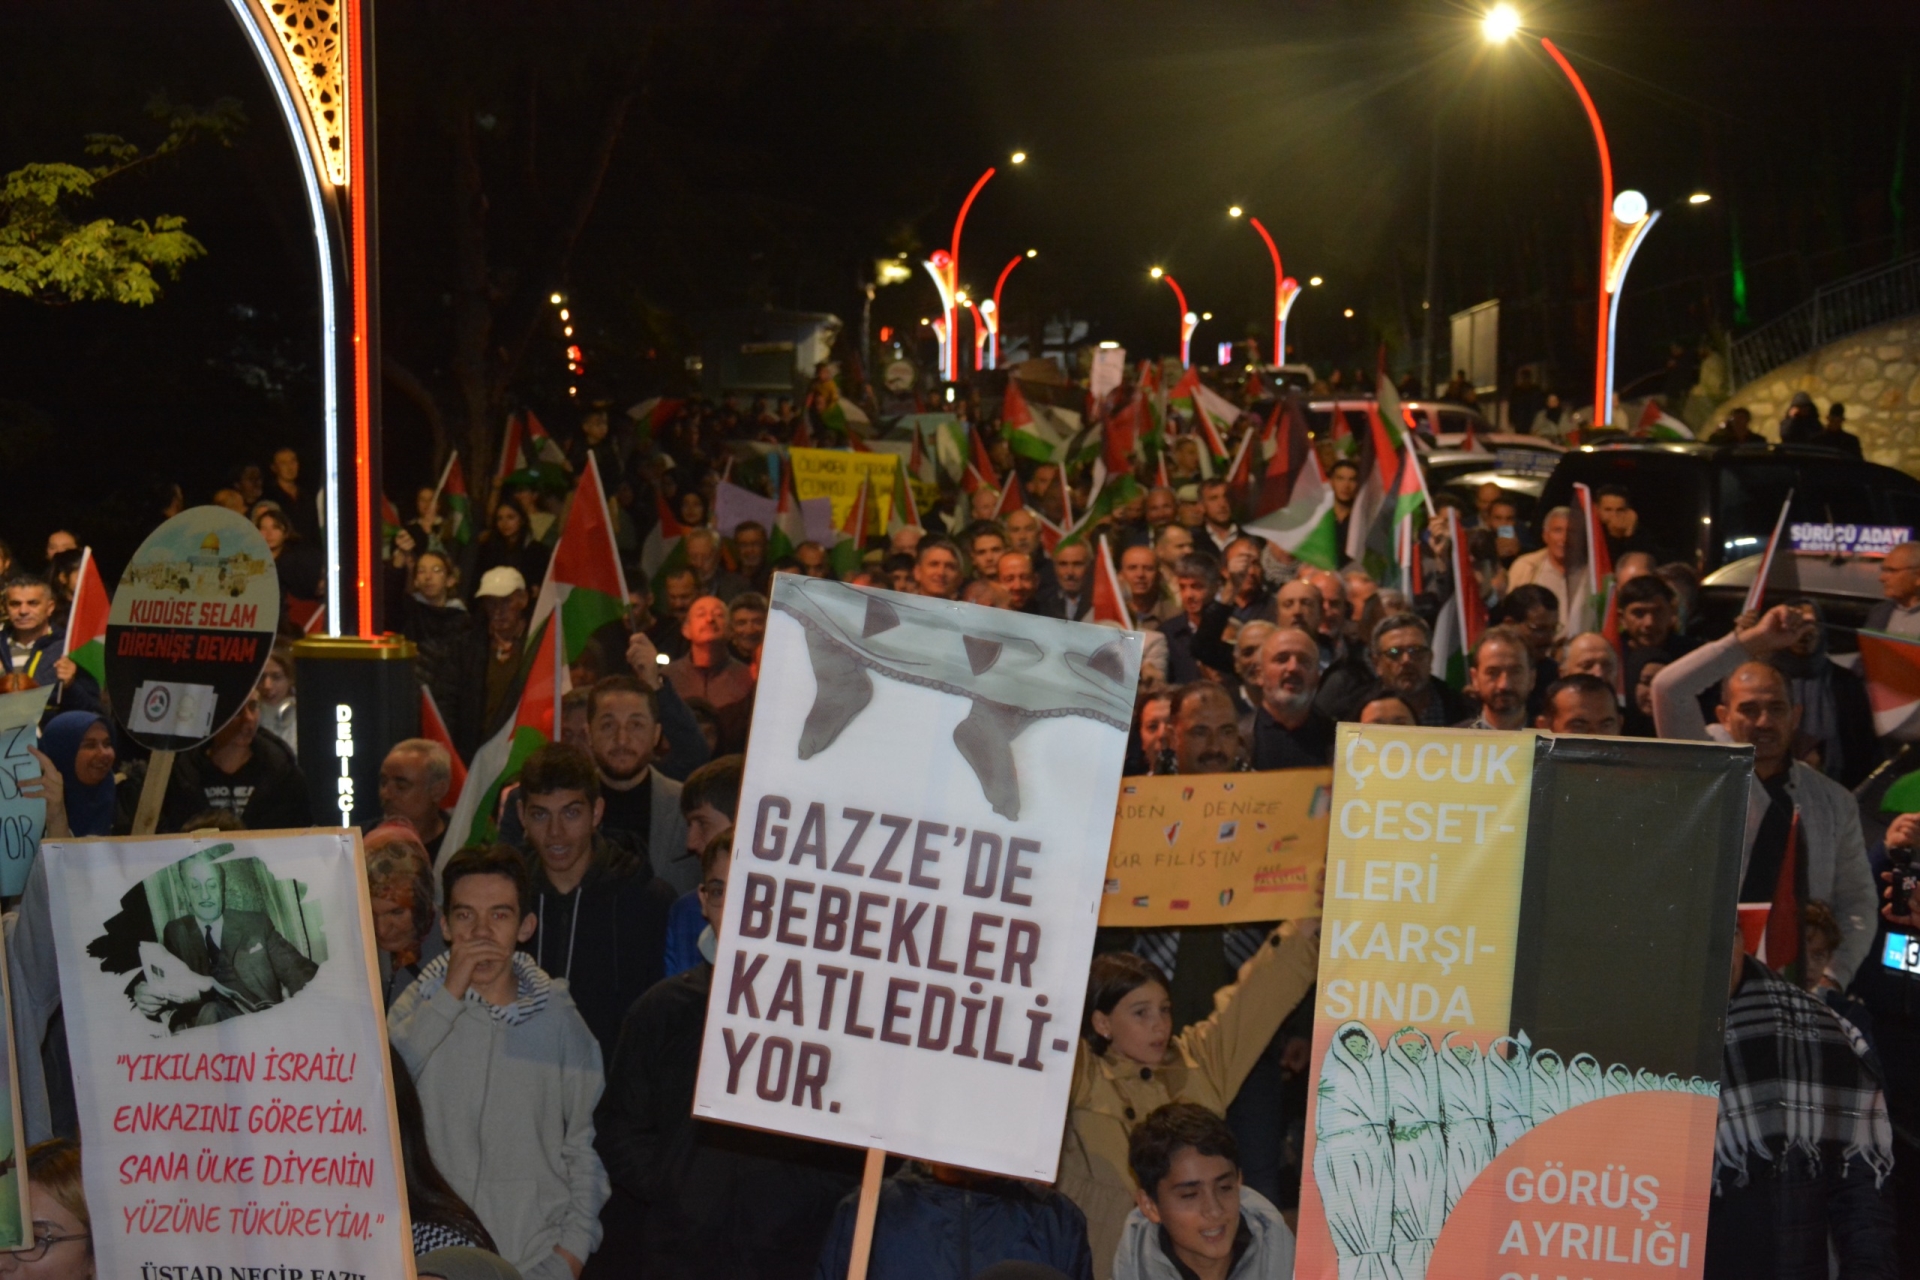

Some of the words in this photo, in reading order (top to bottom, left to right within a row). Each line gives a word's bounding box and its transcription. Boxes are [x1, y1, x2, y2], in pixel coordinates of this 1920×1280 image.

[1790, 522, 1857, 543] SÜRÜCÜ
[1858, 527, 1909, 544] ADAYI
[129, 596, 197, 626] KUDÜSE
[198, 602, 258, 629] SELAM
[117, 627, 195, 663] DİRENİŞE
[195, 635, 258, 663] DEVAM
[1345, 739, 1519, 791] ÇOCUK
[0, 814, 34, 860] OR
[1339, 799, 1515, 845] CESET-
[752, 795, 1041, 906] GAZZE'DE
[1334, 853, 1439, 904] LERİ
[739, 872, 1042, 988] BEBEKLER
[1329, 919, 1496, 976] KARŞI-
[727, 950, 1069, 1072] KATLEDİLİ-
[1324, 978, 1475, 1026] SINDA
[263, 1046, 357, 1084] İSRAİL!
[722, 1028, 841, 1114] YOR.
[113, 1102, 242, 1135] ENKAZINI
[248, 1098, 367, 1136] GÖREYİM.
[119, 1152, 189, 1185] SANA
[197, 1148, 255, 1184] ÜLKE
[262, 1150, 375, 1188] DİYENİN
[1505, 1160, 1660, 1221] GÖRÜŞ
[123, 1198, 221, 1234] YÜZÜNE
[1498, 1220, 1690, 1268] AYRILIĞI
